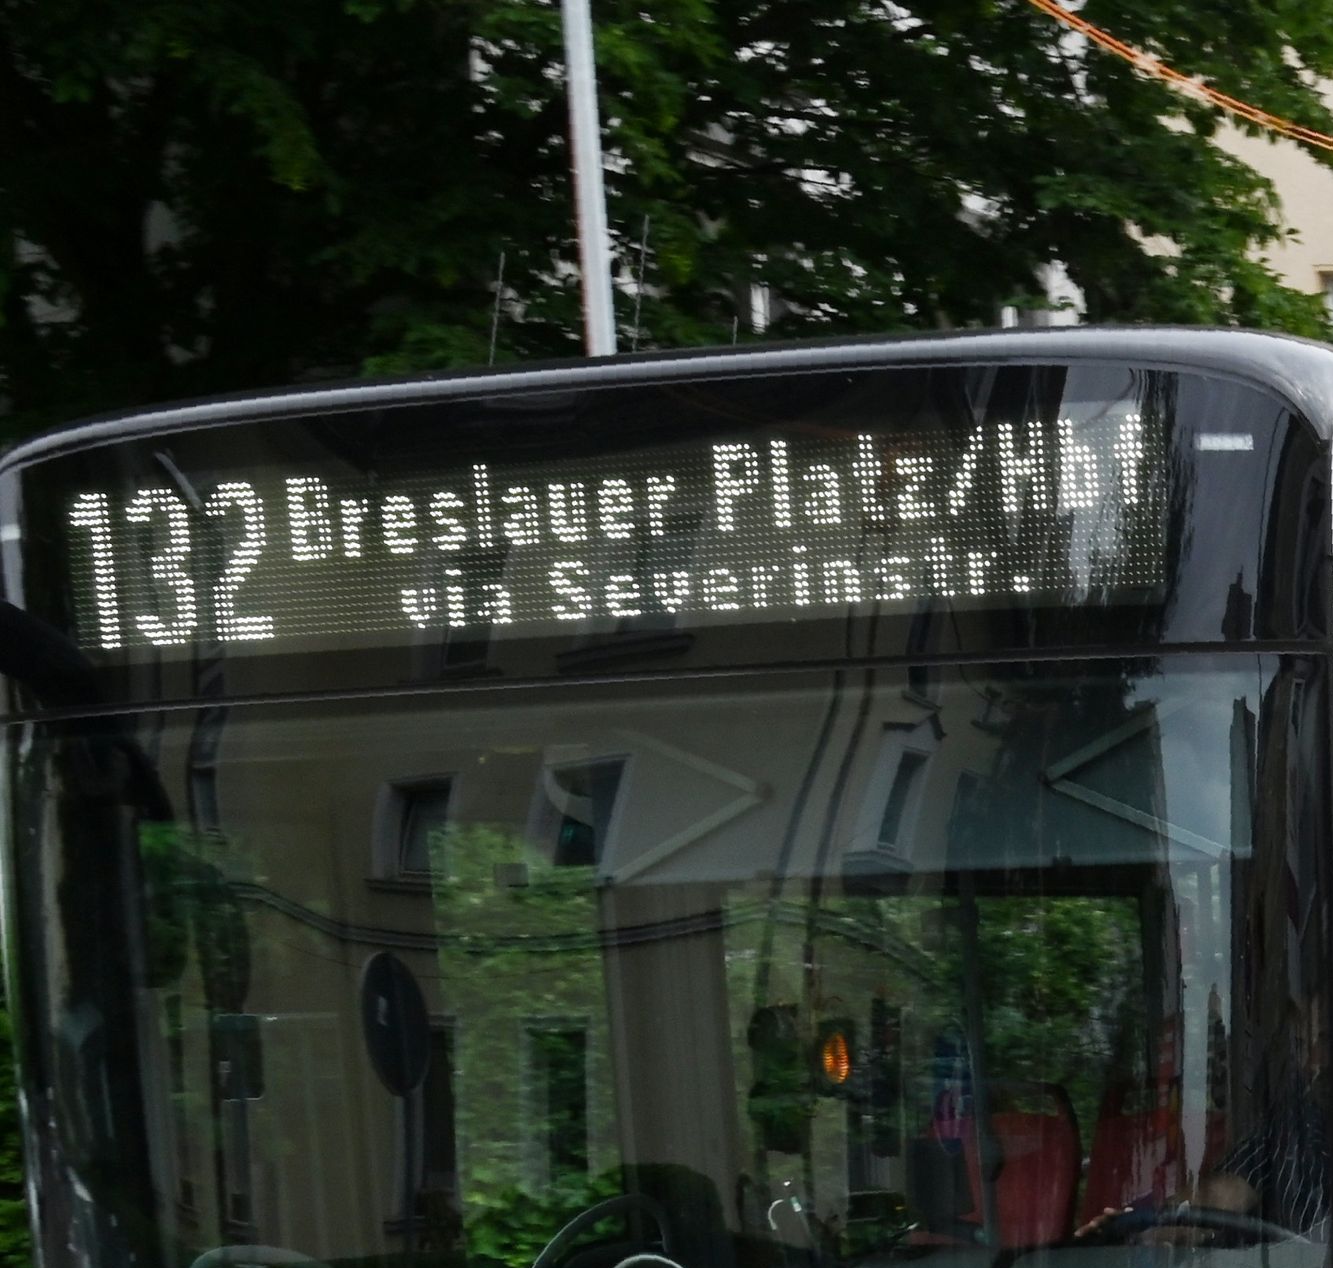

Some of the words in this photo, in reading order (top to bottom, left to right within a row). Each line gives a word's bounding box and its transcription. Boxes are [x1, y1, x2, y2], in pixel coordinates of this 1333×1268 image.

[68, 482, 275, 649] 132
[286, 464, 678, 561] Breslauer
[711, 414, 1146, 532] Platz/Hbf
[401, 569, 513, 629] via
[548, 537, 1032, 621] Severinstr.
